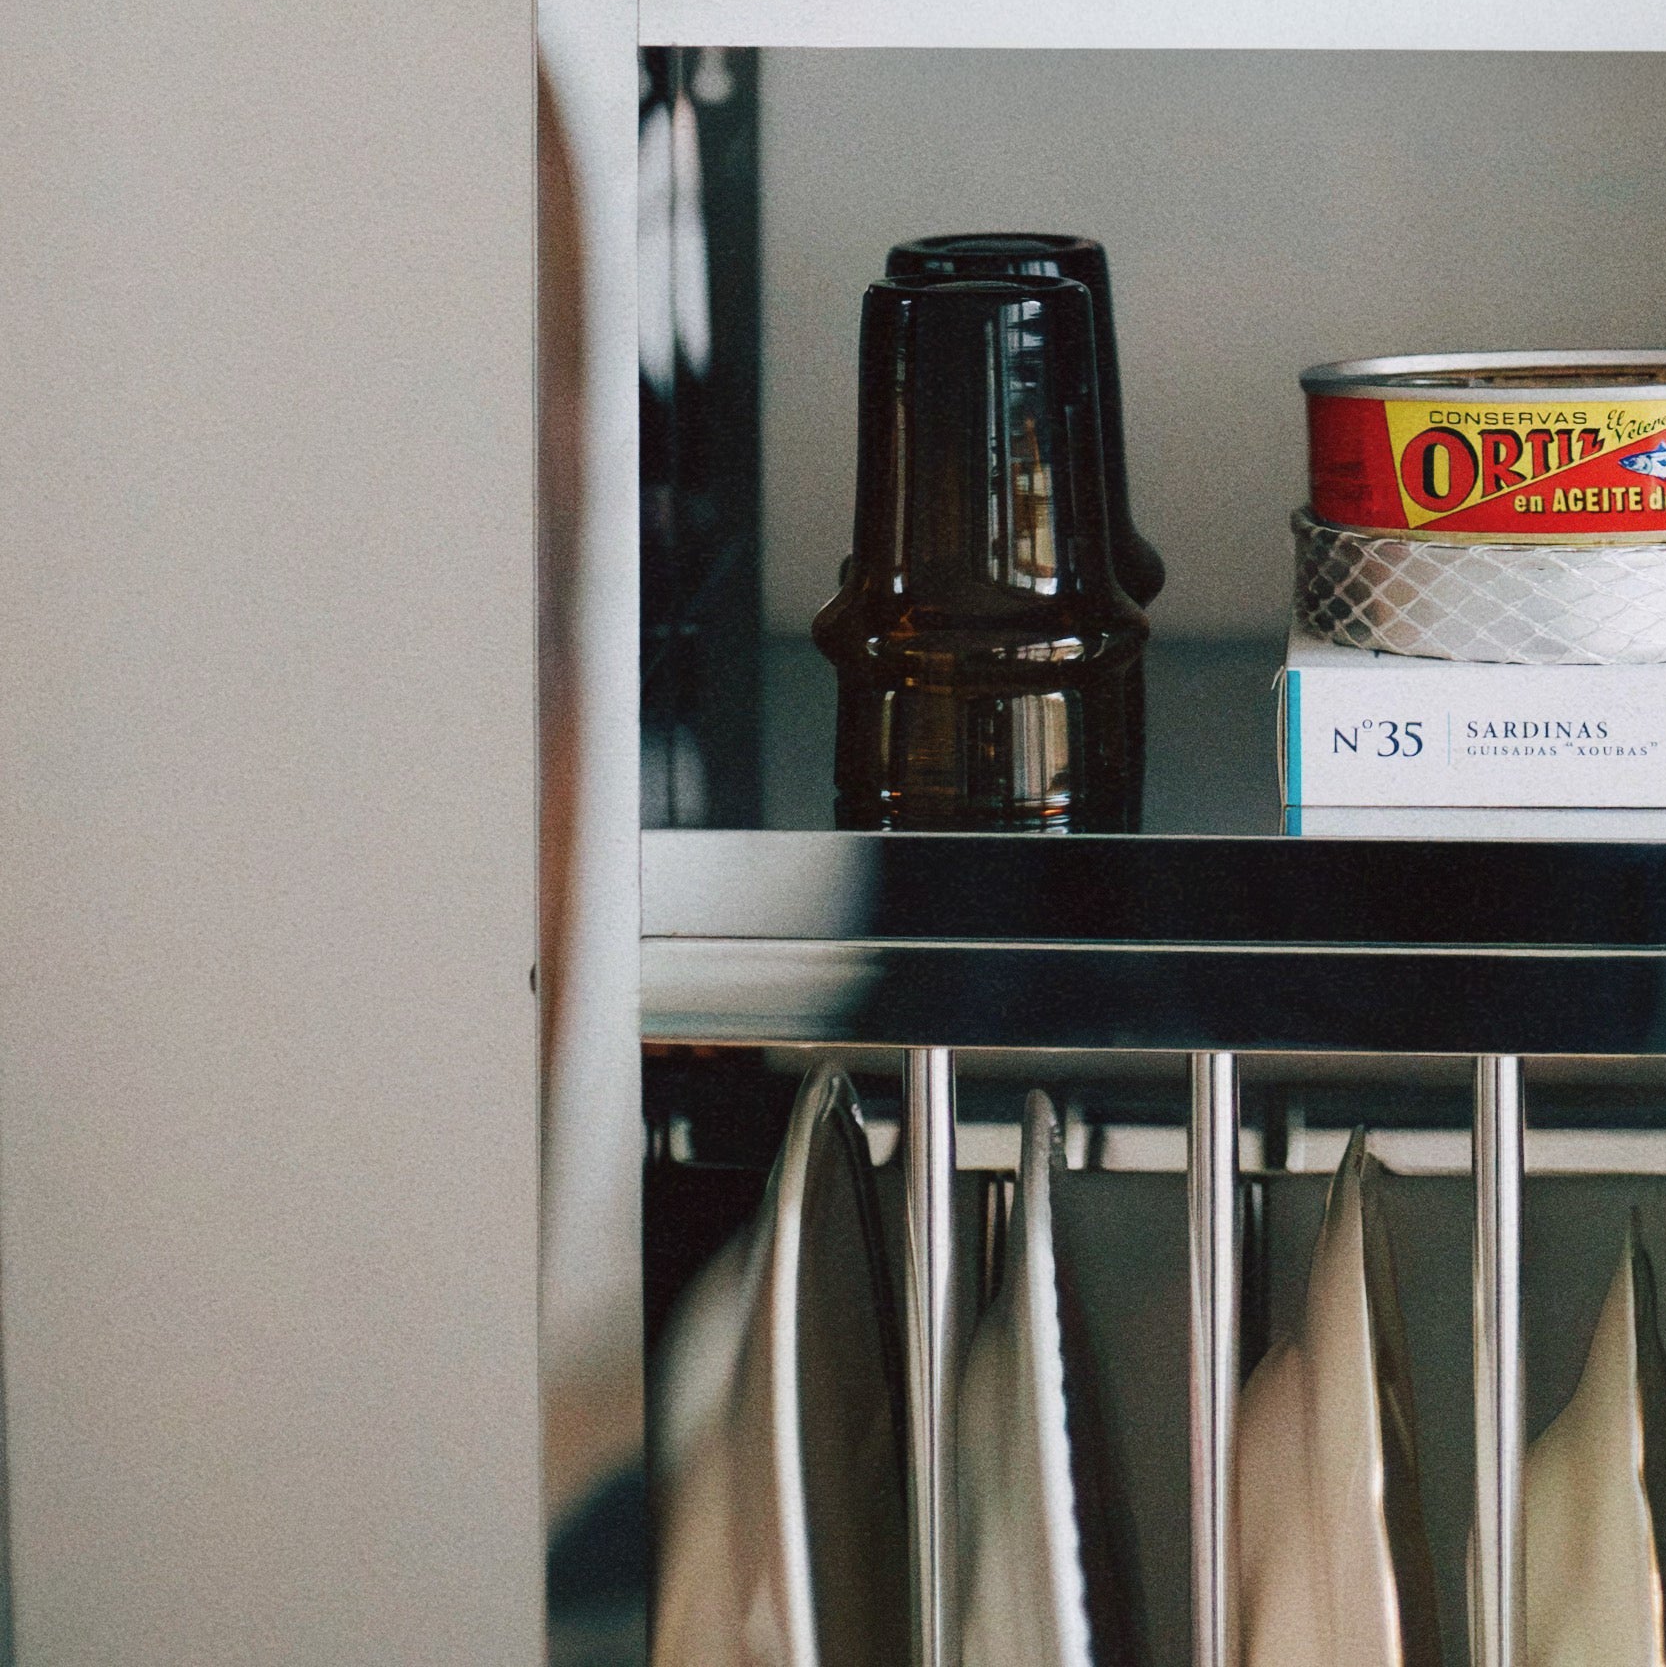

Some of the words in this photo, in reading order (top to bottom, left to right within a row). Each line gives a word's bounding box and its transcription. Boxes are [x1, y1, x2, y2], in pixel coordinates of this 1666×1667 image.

[1429, 410, 1588, 426] CONSERVAS
[1400, 426, 1606, 513] ORTIZ
[1513, 495, 1545, 514] en
[1552, 486, 1645, 514] ACEITE
[1466, 721, 1609, 740] SARDINAS
[1466, 745, 1558, 757] GUISADAS
